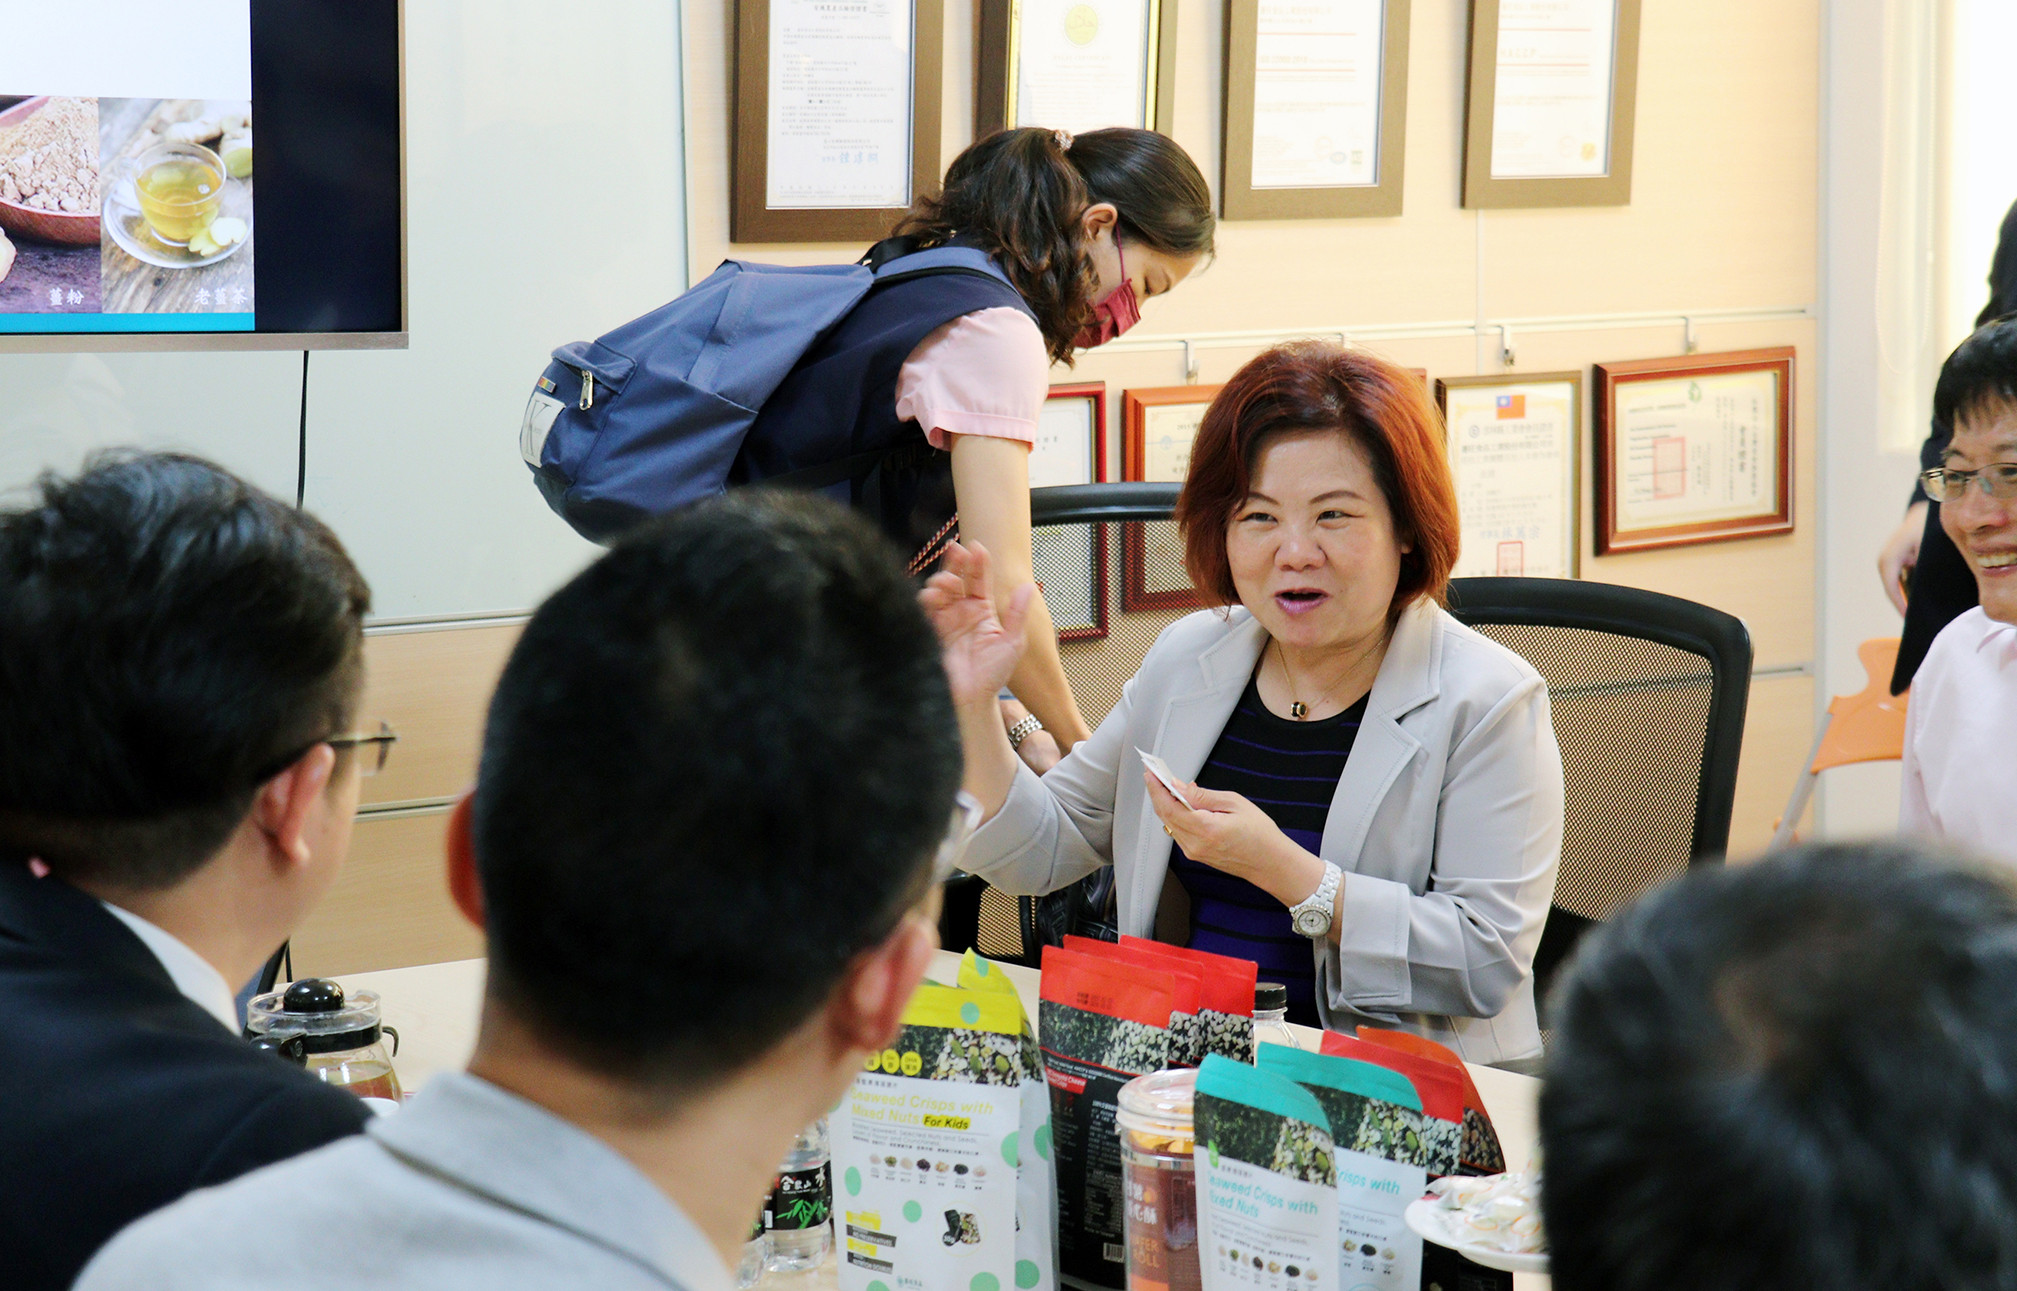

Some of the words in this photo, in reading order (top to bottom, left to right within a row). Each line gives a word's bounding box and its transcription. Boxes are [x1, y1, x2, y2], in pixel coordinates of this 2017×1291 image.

[49, 287, 85, 306] 薑粉
[194, 287, 248, 306] 老薑茶
[850, 1087, 906, 1107] Seaweed
[910, 1095, 956, 1113] Crisps
[961, 1101, 994, 1115] with
[851, 1103, 886, 1120] Mixed
[888, 1110, 921, 1125] Nuts
[924, 1115, 941, 1127] For
[945, 1116, 969, 1130] Kids
[1370, 1178, 1400, 1195] with
[1210, 1191, 1234, 1209] ixed
[1236, 1199, 1260, 1218] Nuts
[1253, 1186, 1284, 1208] Crisps
[1287, 1198, 1319, 1216] with
[1130, 1236, 1160, 1253] AFER
